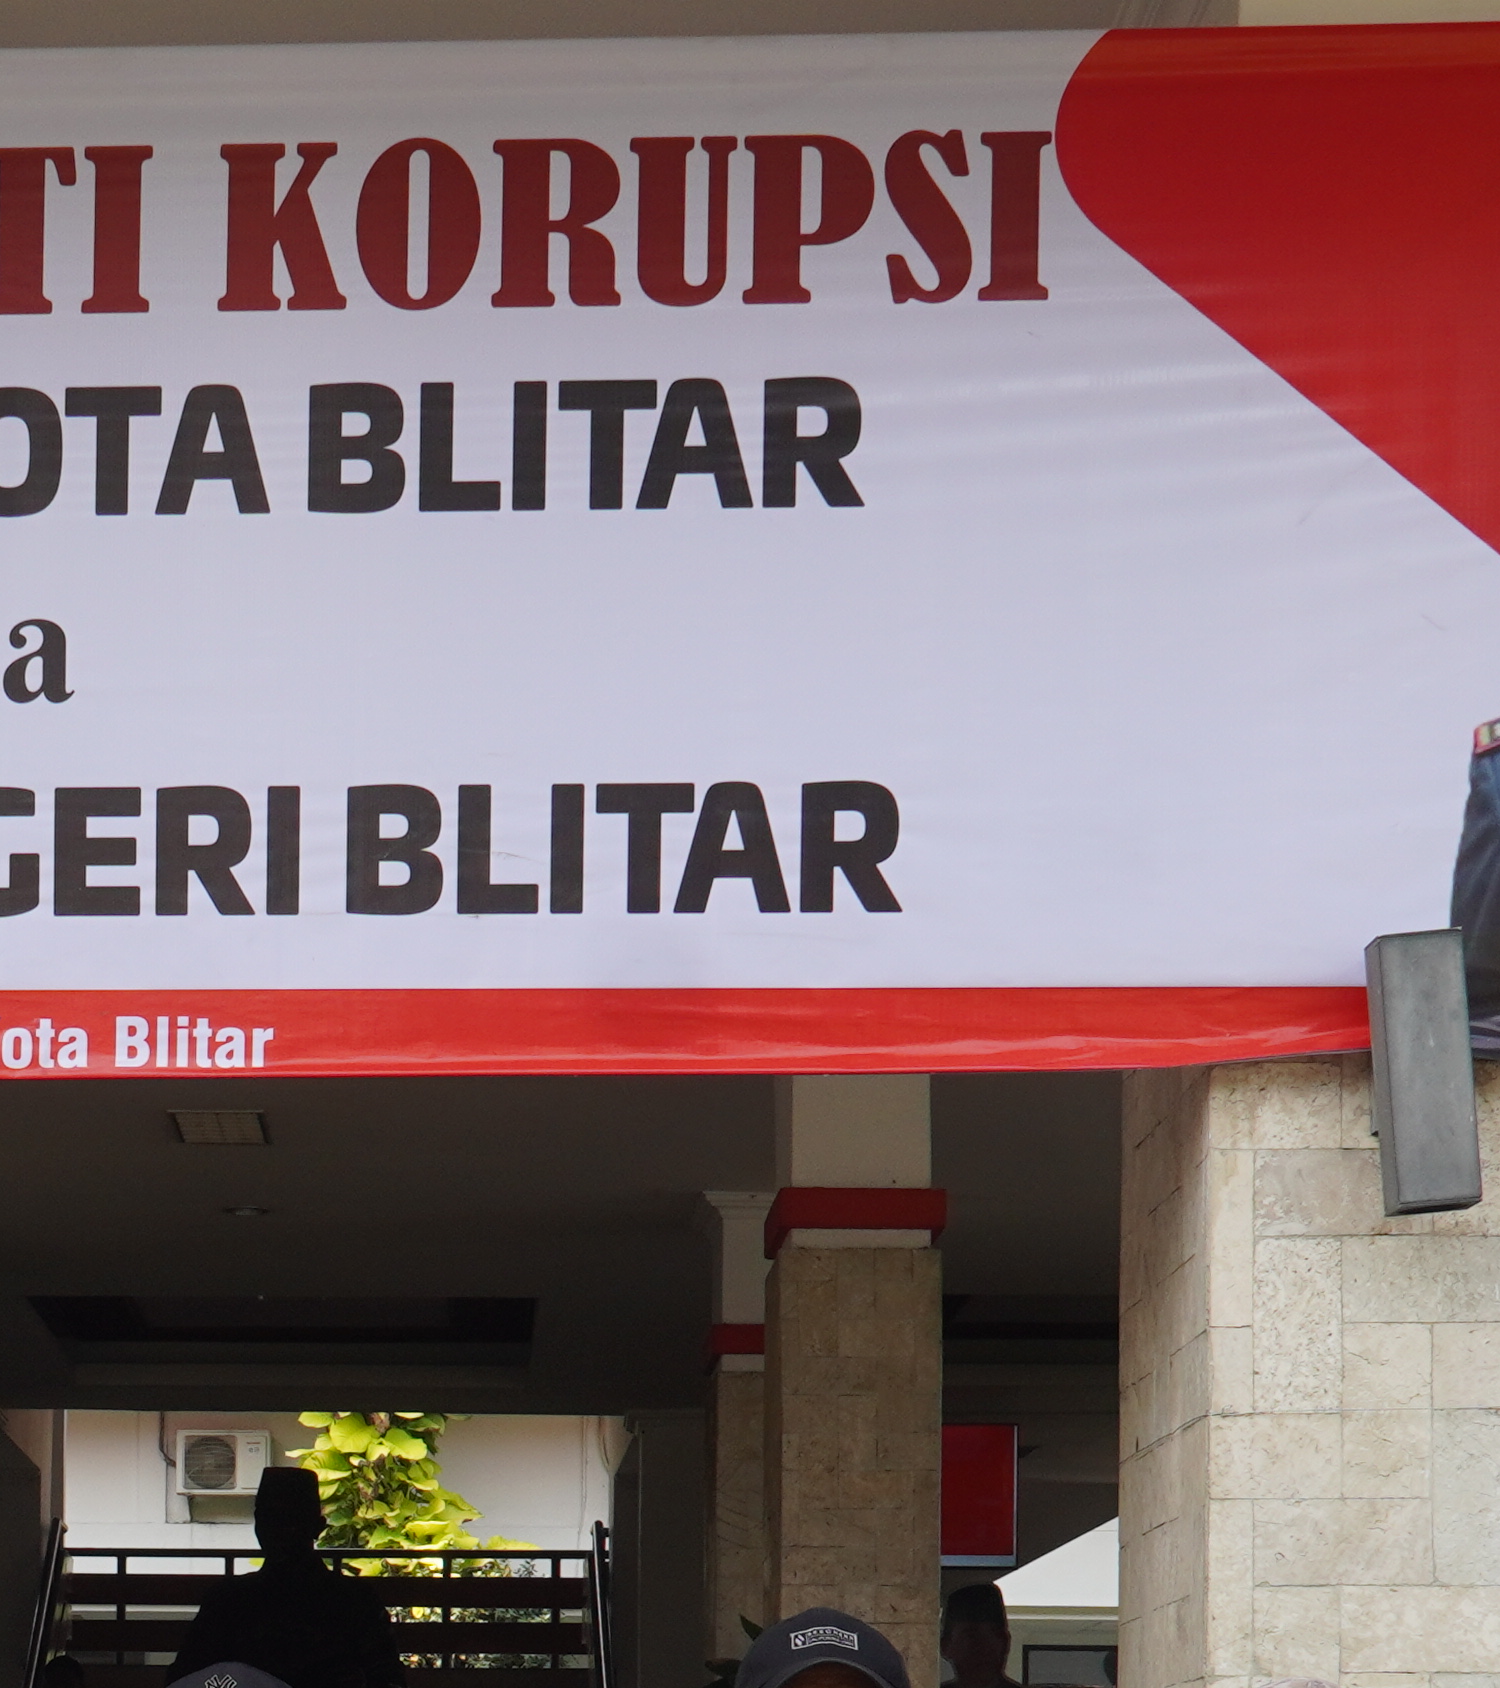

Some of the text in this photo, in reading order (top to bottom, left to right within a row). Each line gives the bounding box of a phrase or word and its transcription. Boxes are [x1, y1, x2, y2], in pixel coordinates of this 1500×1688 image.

[216, 128, 1054, 311] KORUPSI
[307, 375, 866, 514] BLITAR
[345, 780, 904, 917] BLITAR
[114, 1016, 276, 1069] Blitar
